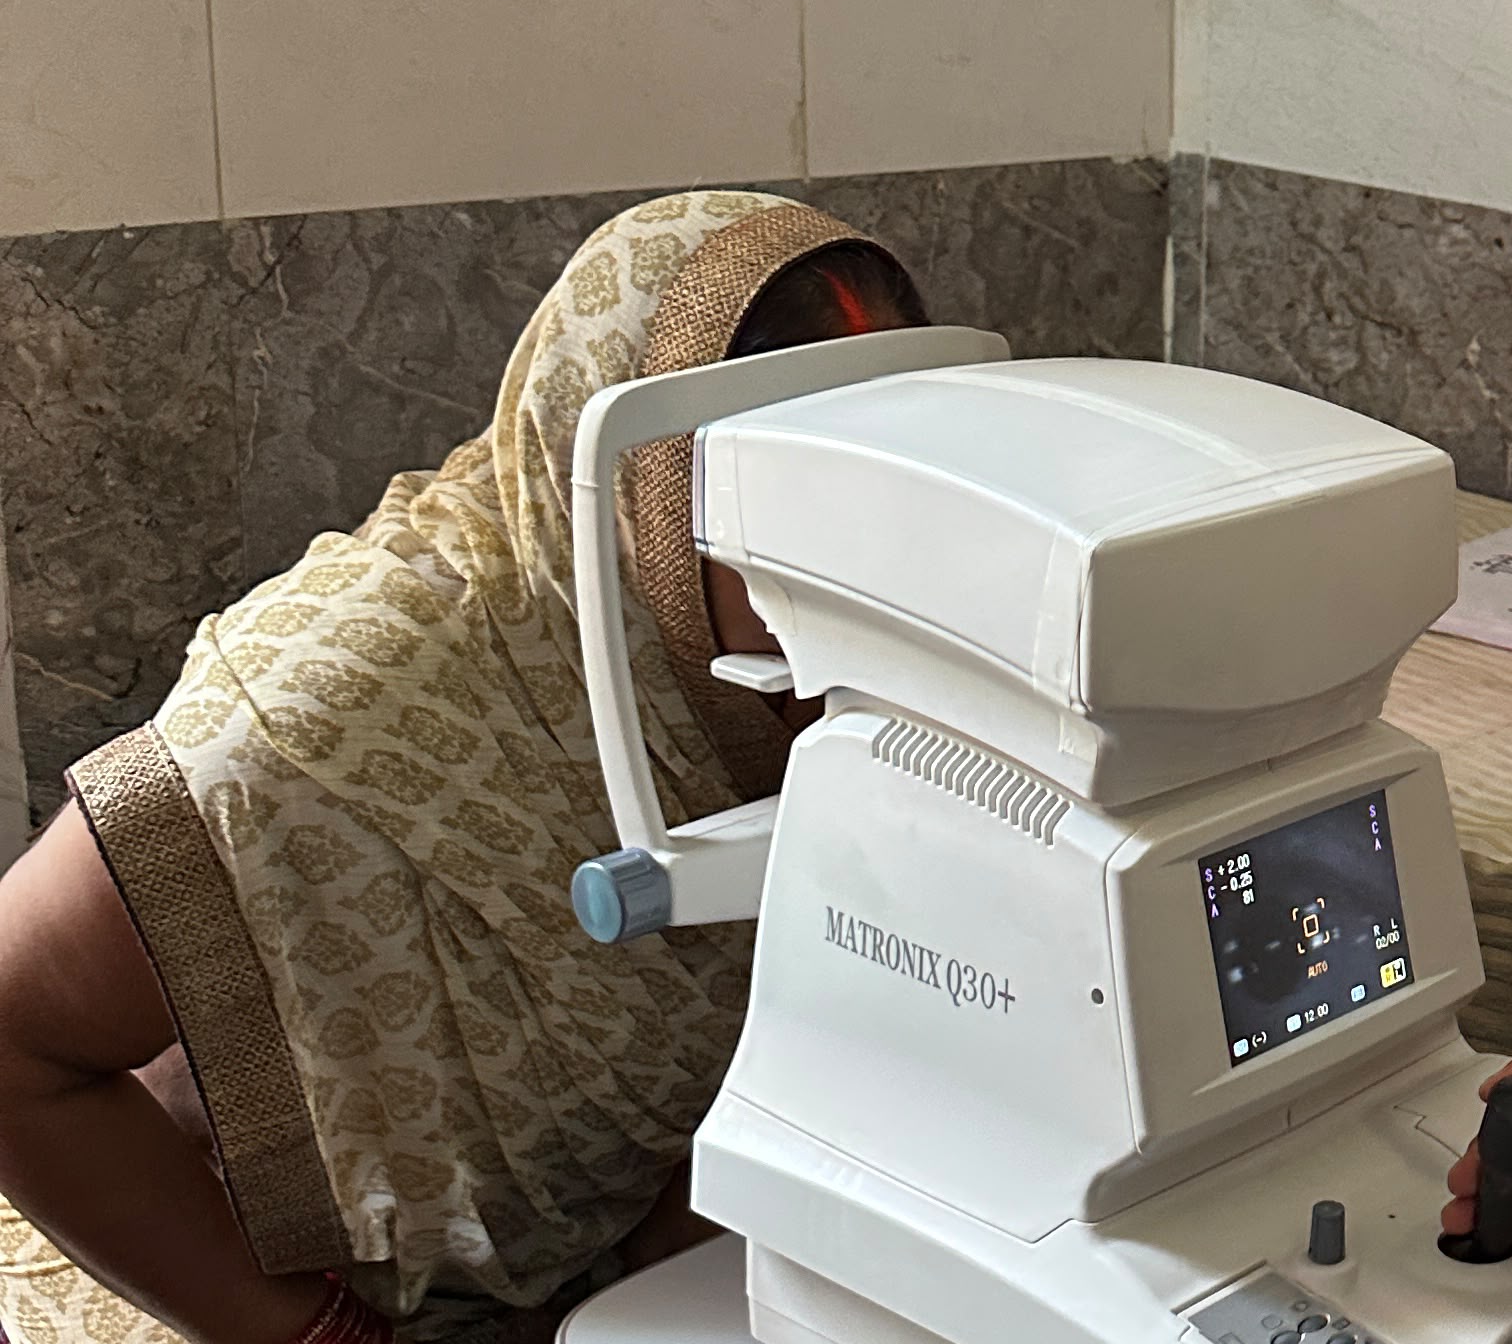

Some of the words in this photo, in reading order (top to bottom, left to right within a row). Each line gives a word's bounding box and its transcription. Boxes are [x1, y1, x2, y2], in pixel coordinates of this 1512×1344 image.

[1369, 805, 1377, 817] S
[1372, 821, 1379, 834] C
[1375, 838, 1382, 851] A
[1205, 868, 1213, 882] S
[1208, 886, 1216, 900] C
[1211, 903, 1220, 917] A
[1243, 889, 1254, 905] 81
[1373, 925, 1381, 936] R
[825, 905, 942, 990] MATRONIX
[946, 959, 1016, 1014] Q30+
[1307, 961, 1328, 979] AUTO
